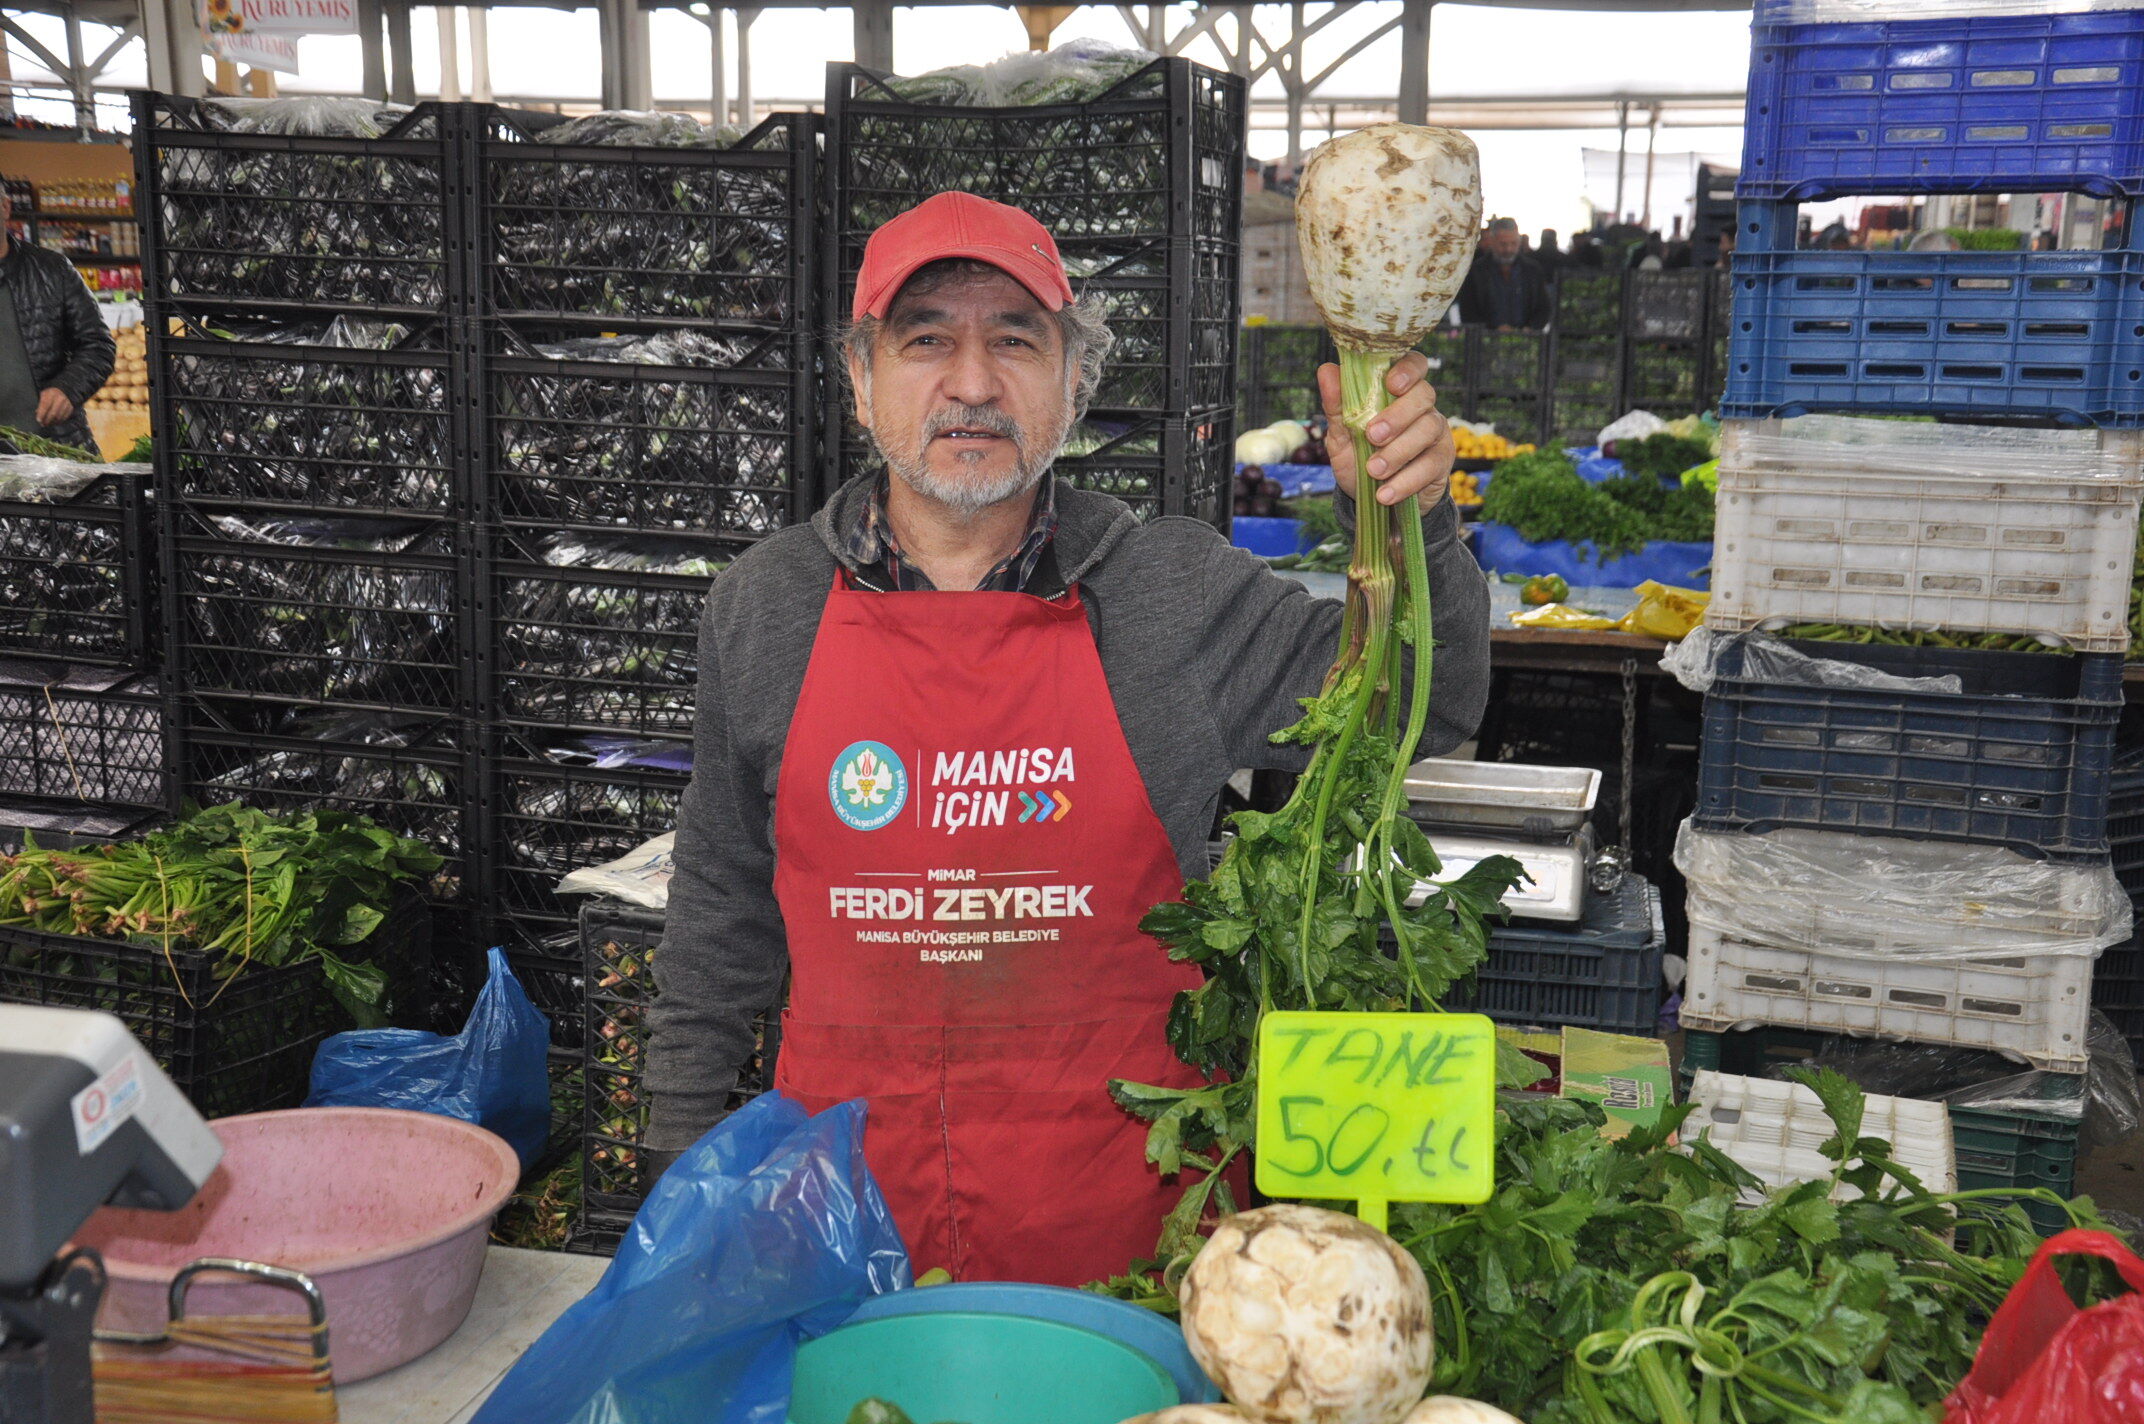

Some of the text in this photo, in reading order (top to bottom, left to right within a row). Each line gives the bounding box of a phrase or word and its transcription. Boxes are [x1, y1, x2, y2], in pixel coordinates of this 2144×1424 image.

[932, 885, 1094, 921] ZEYREK
[920, 949, 983, 965] BAŞKANI
[1273, 1027, 1489, 1089] TANE
